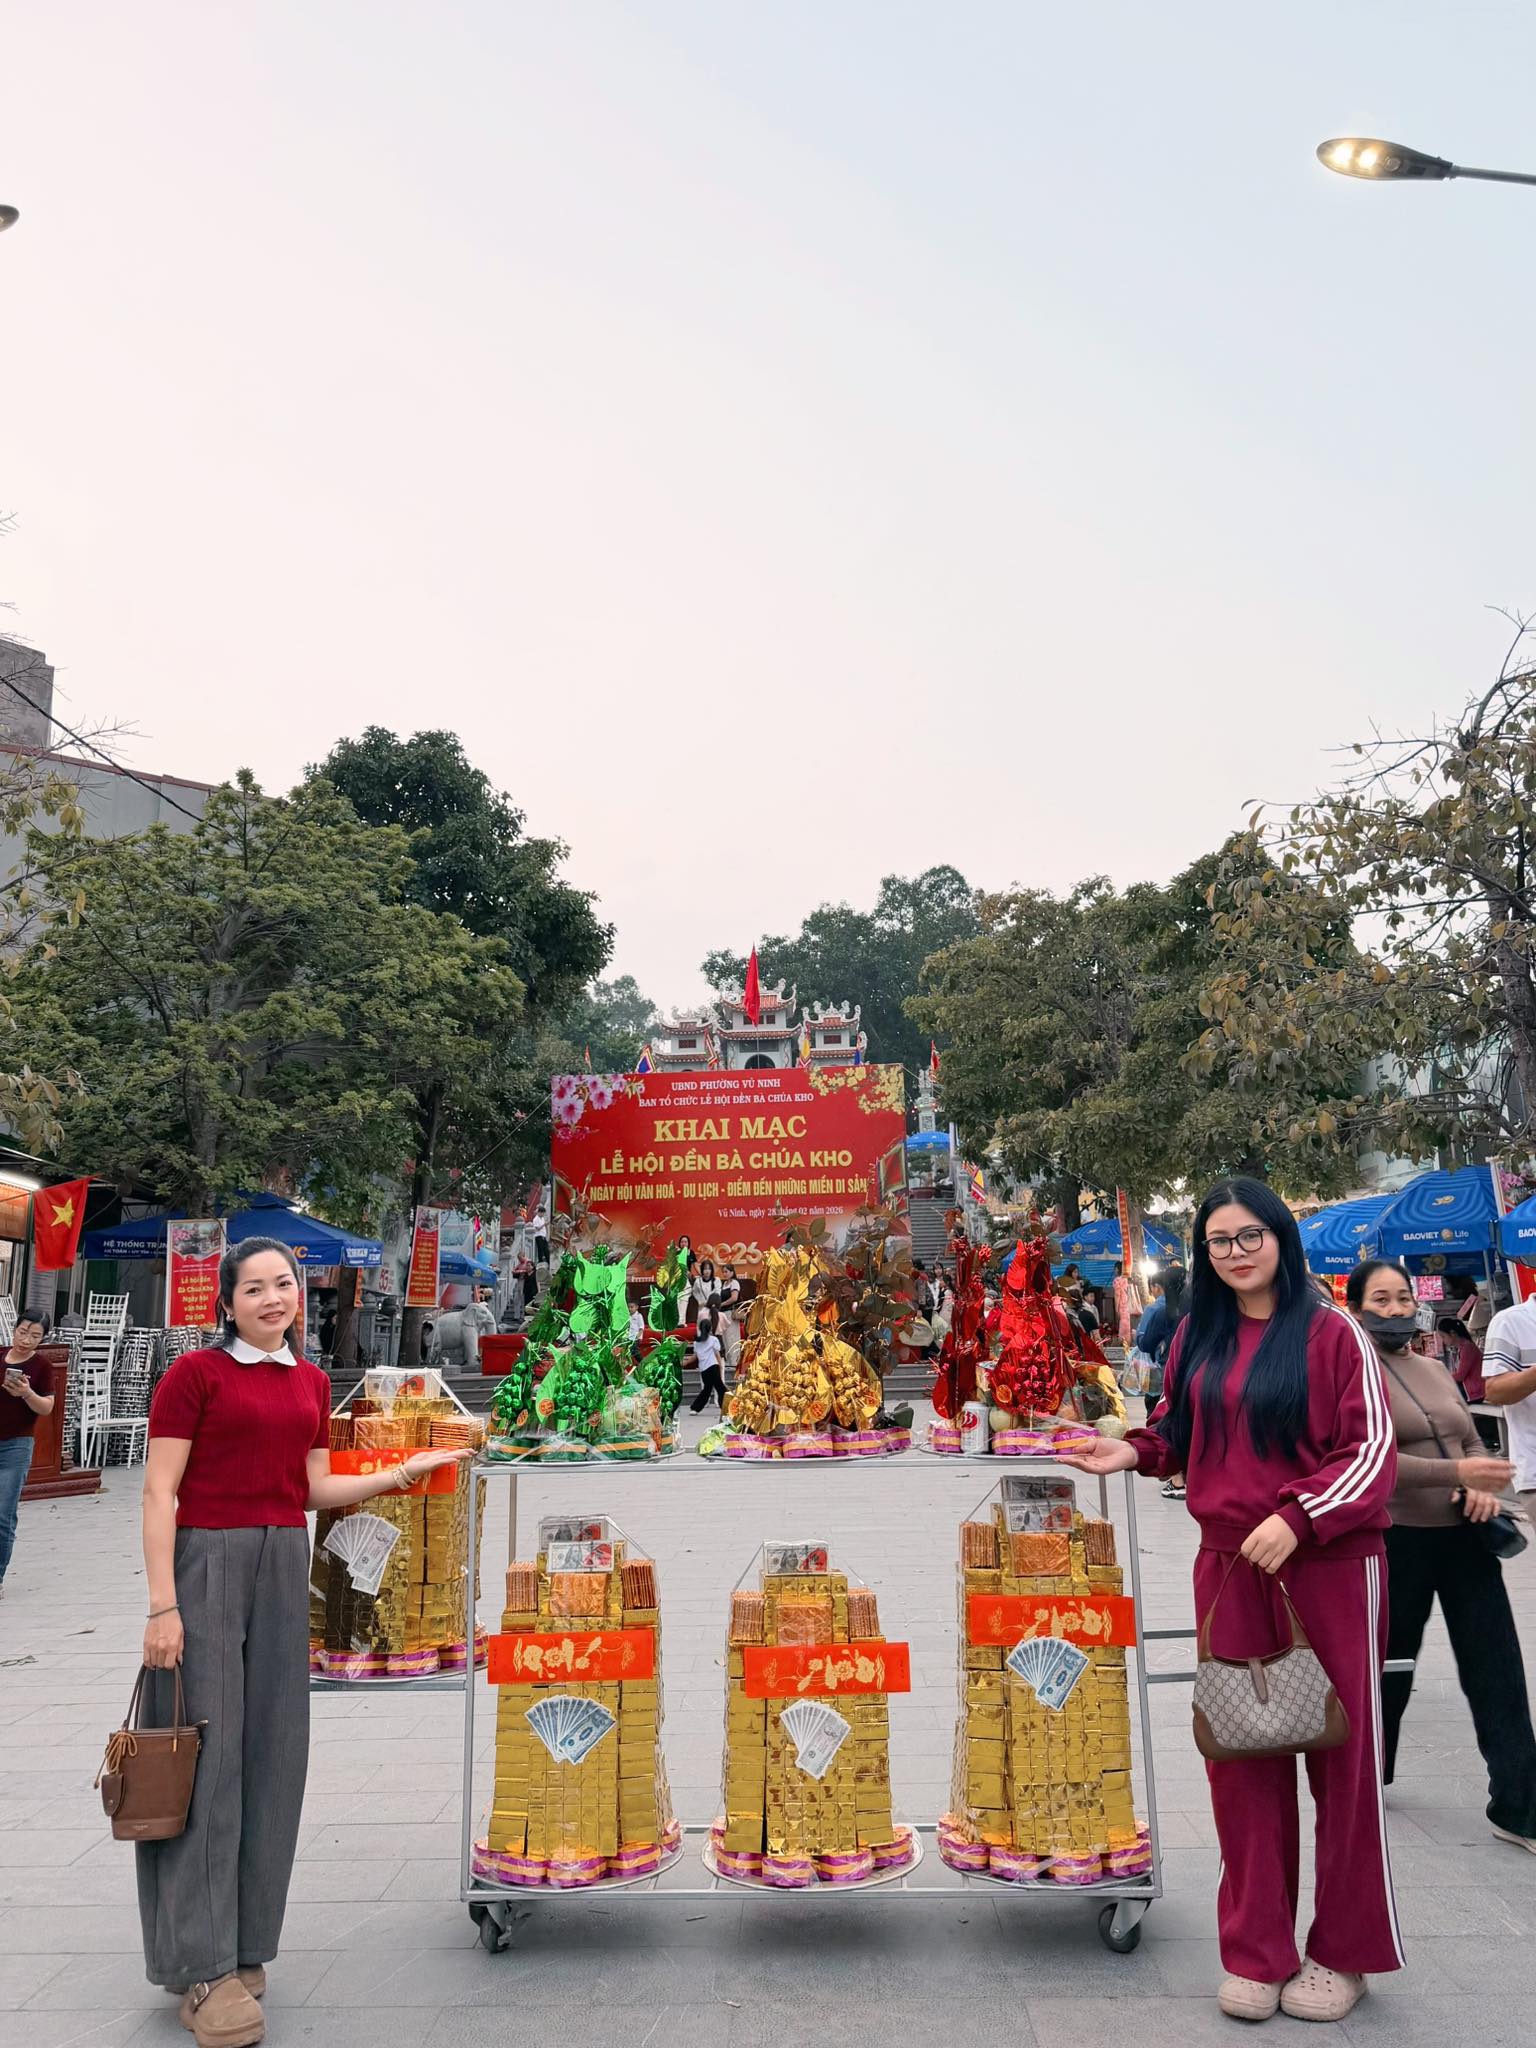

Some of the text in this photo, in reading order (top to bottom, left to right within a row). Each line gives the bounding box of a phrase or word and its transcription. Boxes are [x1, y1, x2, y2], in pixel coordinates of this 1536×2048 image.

[671, 1081, 698, 1091] UBND
[700, 1078, 739, 1090] PHƯỜNG
[757, 1078, 781, 1088] NINH
[639, 1098, 657, 1107] BAN
[673, 1095, 698, 1106] CHỨC
[714, 1093, 730, 1106] HỘI
[753, 1092, 766, 1103] BÀ
[767, 1092, 793, 1103] CHÚA
[794, 1092, 814, 1102] KHO
[654, 1115, 807, 1145] KHAI MẠC
[600, 1147, 853, 1176] LỄ HỘI ĐỀN BÀ CHÚA KHO
[590, 1183, 614, 1201] NGÀY
[617, 1182, 633, 1203] HỘI
[635, 1182, 654, 1200] VĂN
[656, 1181, 675, 1199] HOÁ
[683, 1183, 696, 1198] DU
[698, 1182, 718, 1200] LỊCH
[727, 1176, 751, 1196] ĐIỂM
[753, 1176, 772, 1195] ĐẾN
[775, 1177, 807, 1195] NHỮNG
[836, 1178, 845, 1194] DI
[848, 1174, 868, 1194] SẢN
[718, 1208, 728, 1217] Vũ
[749, 1207, 765, 1218] ngày
[767, 1208, 777, 1216] 28
[778, 1207, 798, 1216] háng
[799, 1207, 807, 1215] 02
[809, 1206, 824, 1215] năm
[826, 1206, 844, 1215] 2026
[1403, 1231, 1439, 1240] BAOVIET
[1518, 1227, 1536, 1239] BAOV
[103, 1239, 167, 1249] HỆ THỐNG TRUN
